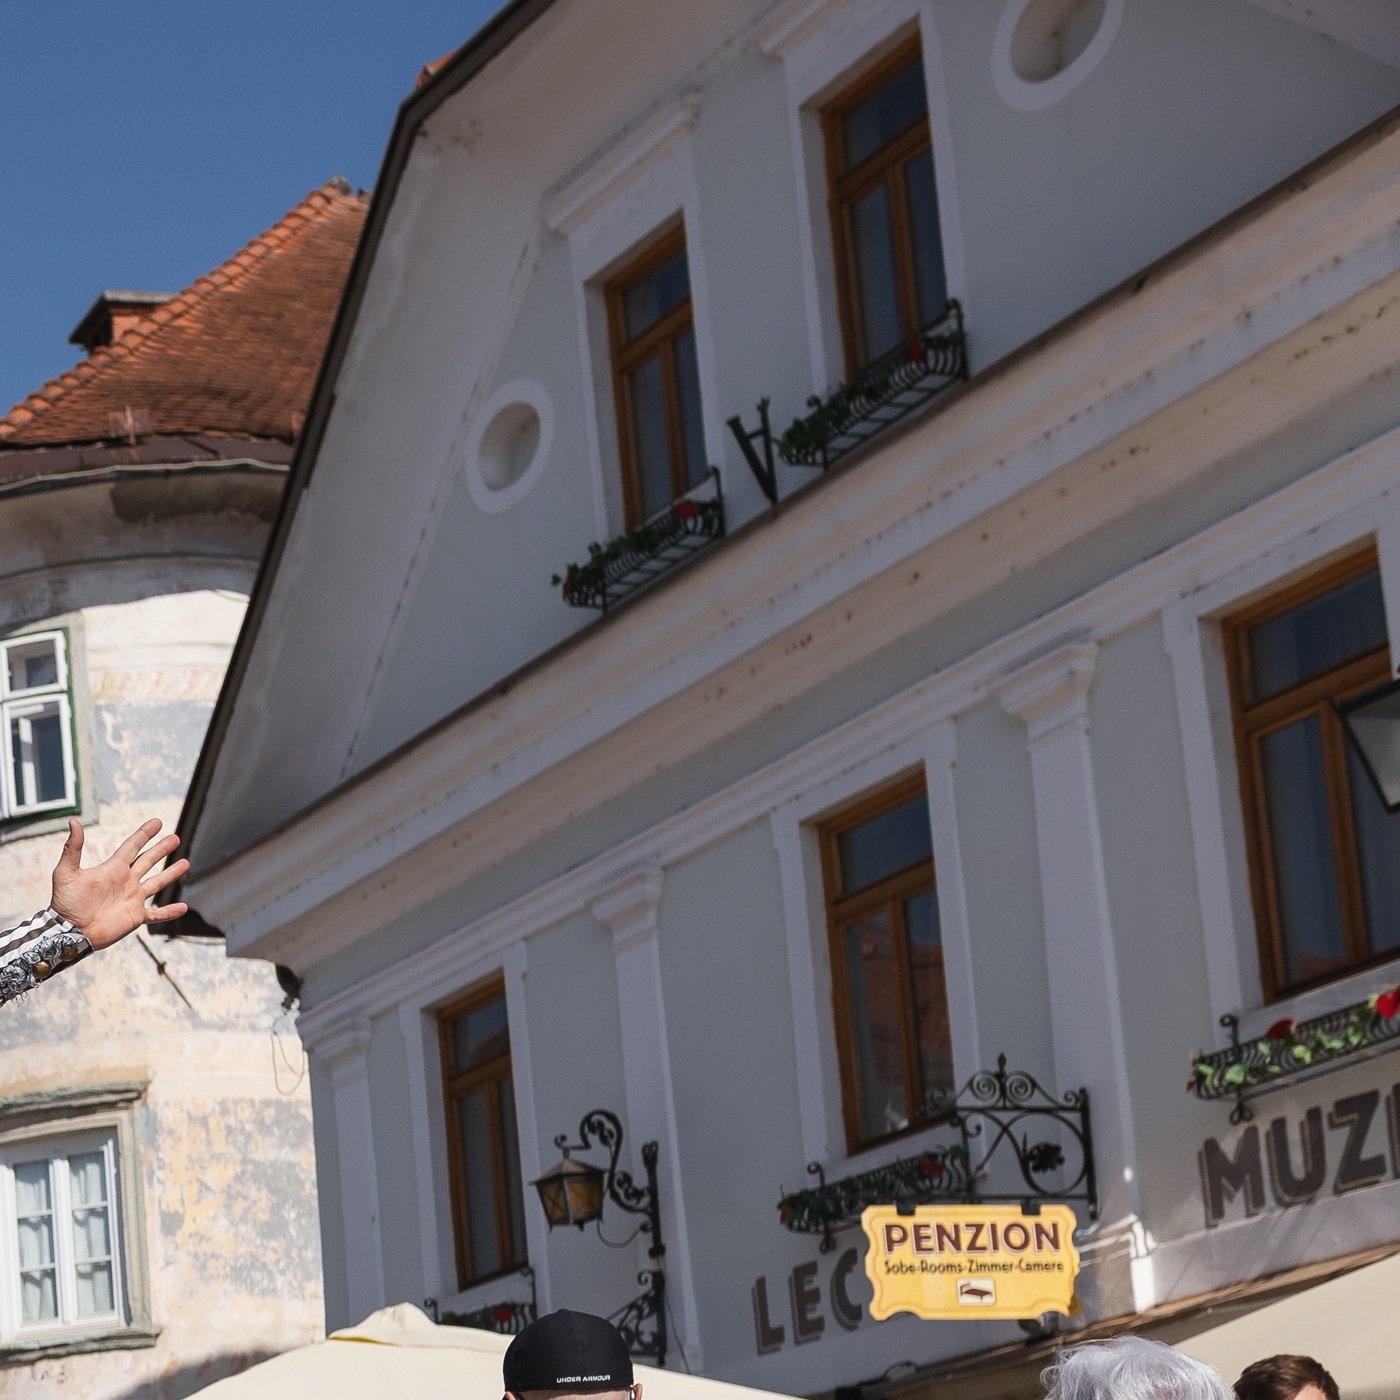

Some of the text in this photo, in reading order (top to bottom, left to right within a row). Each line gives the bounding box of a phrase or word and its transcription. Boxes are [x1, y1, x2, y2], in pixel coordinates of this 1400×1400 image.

[1198, 1084, 1400, 1229] MUZ
[884, 1223, 1061, 1255] PENZION
[751, 1246, 864, 1357] LEC
[556, 1374, 611, 1384] UNDER ARMOUR
